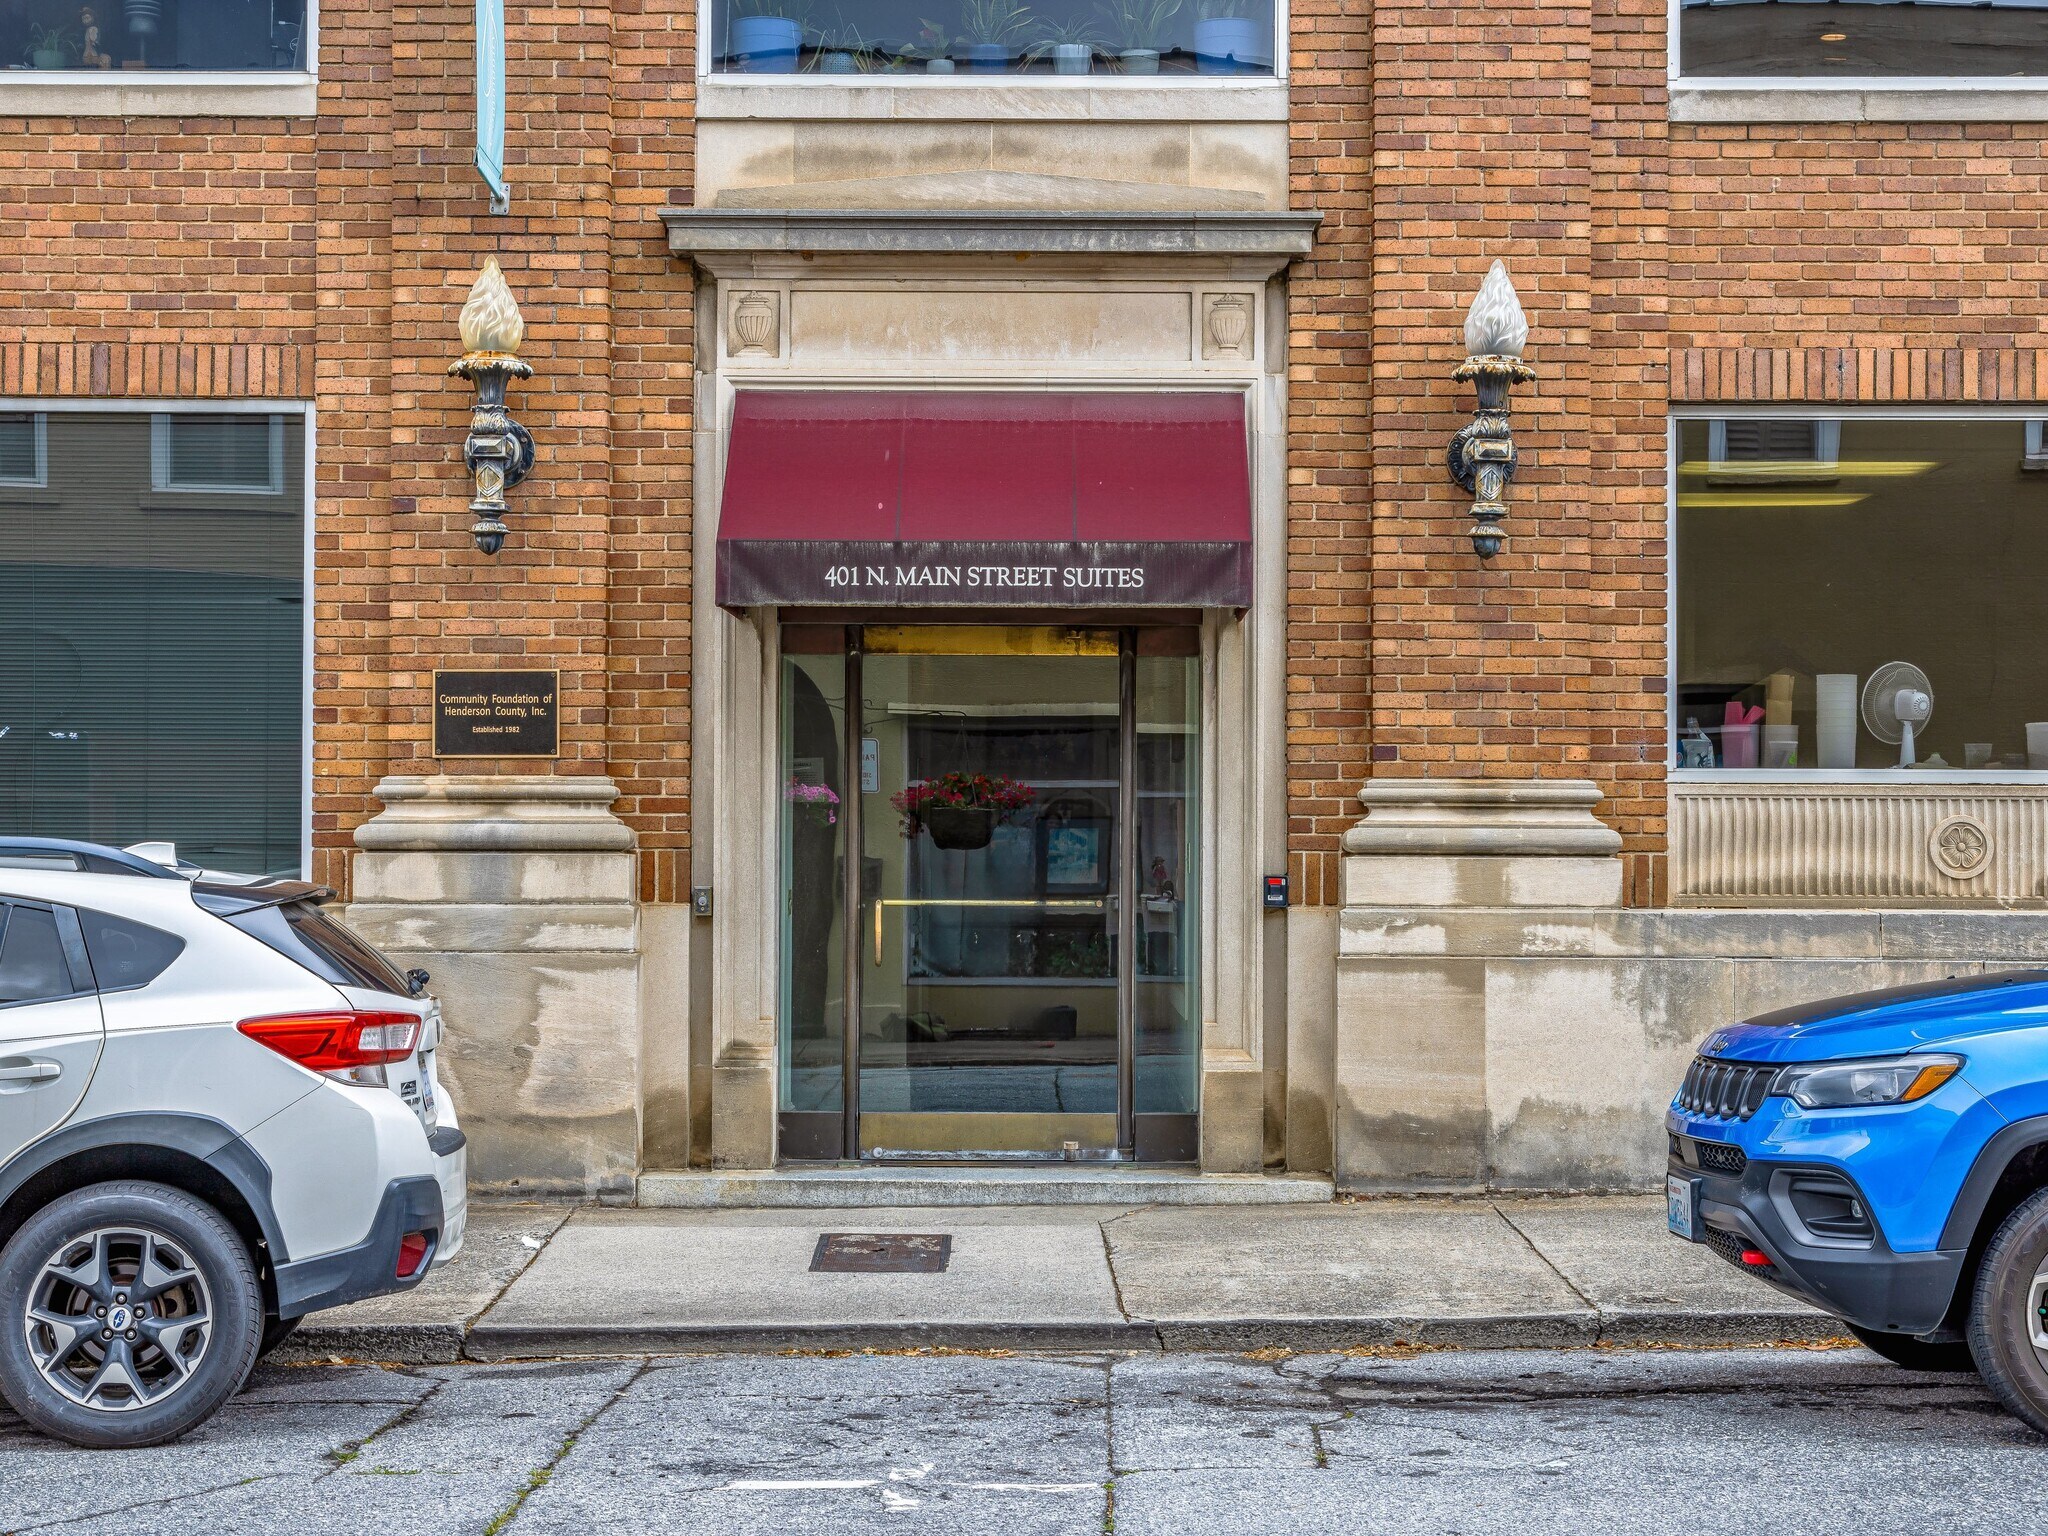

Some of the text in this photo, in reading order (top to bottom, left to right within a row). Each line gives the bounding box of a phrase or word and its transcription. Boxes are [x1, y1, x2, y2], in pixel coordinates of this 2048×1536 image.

[824, 565, 1145, 588] 401 N. MAIN STREET SUITES
[439, 693, 553, 706] Community Foundation of
[444, 706, 547, 718] Henderson County, Inc.
[472, 725, 520, 733] Established 1982
